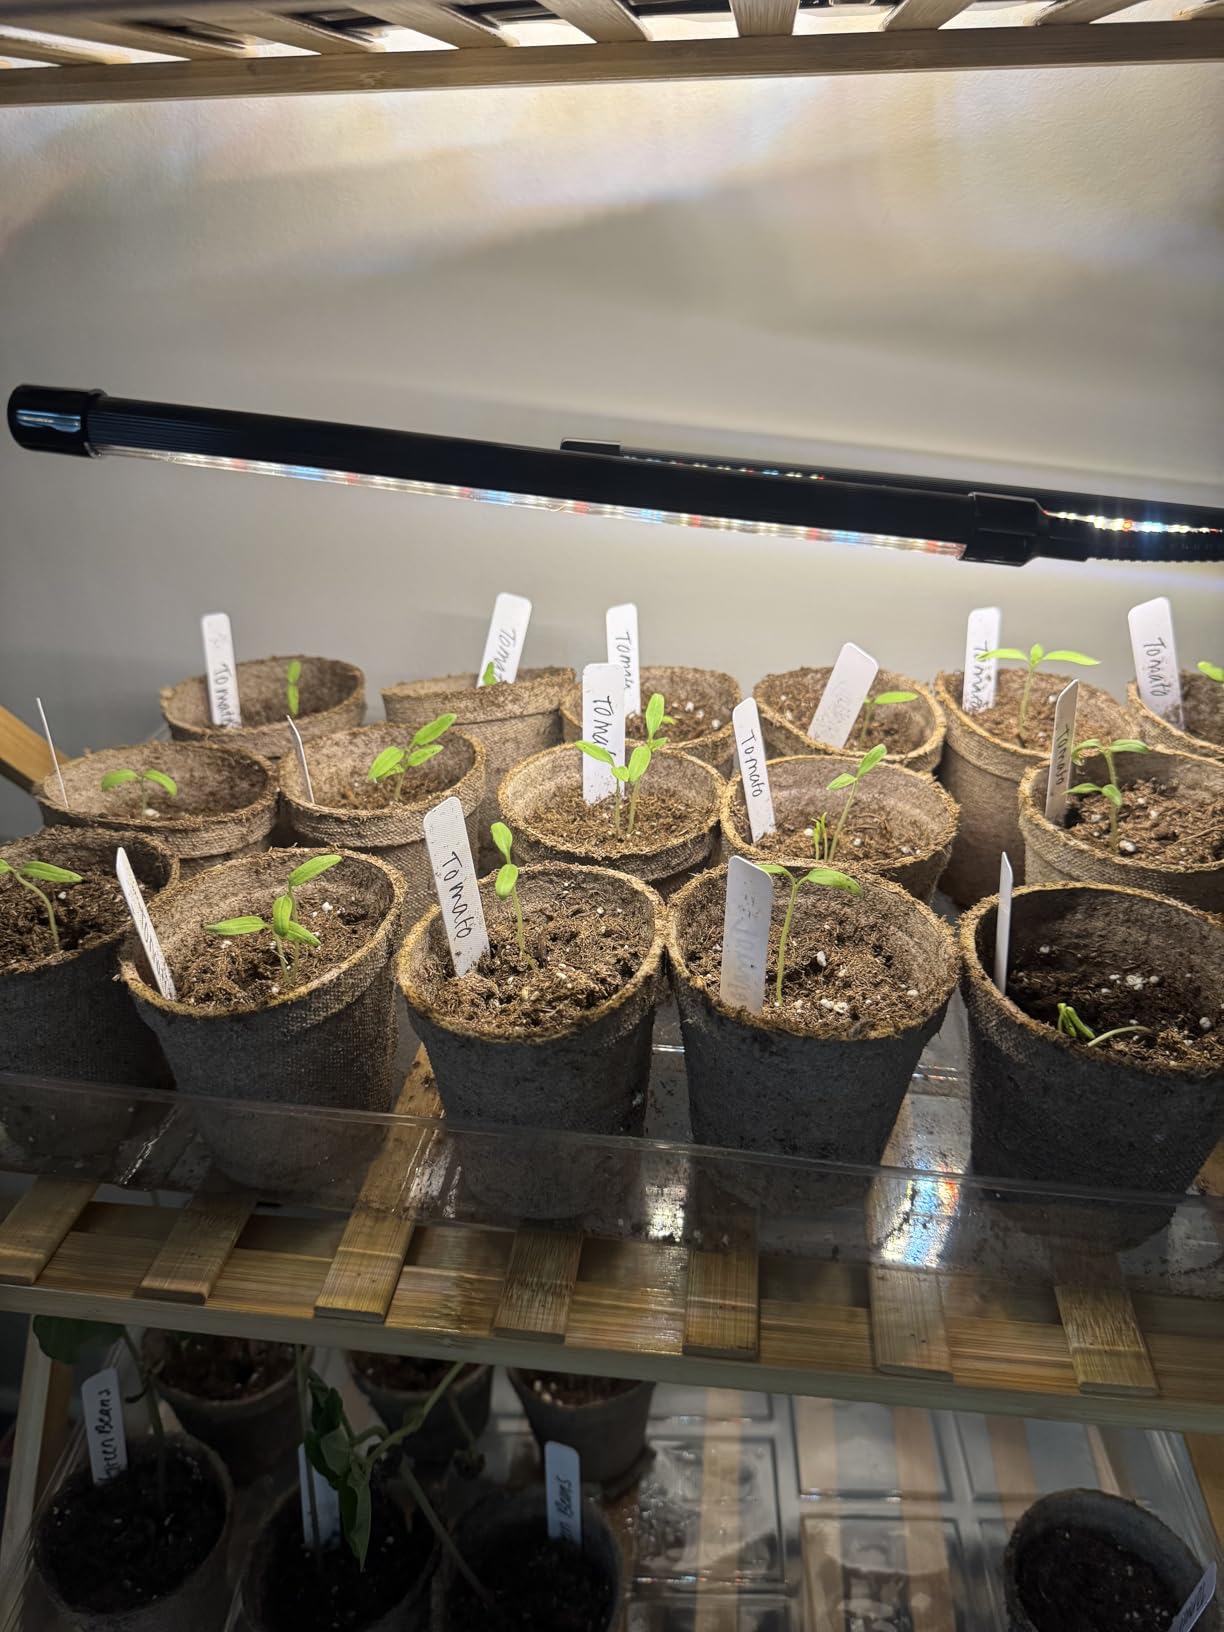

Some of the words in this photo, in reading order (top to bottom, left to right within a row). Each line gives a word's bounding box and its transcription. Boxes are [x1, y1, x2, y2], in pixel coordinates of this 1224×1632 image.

[1143, 636, 1171, 697] Tomato
[741, 729, 765, 798] Tomato
[442, 851, 475, 939] Tomato
[95, 1388, 113, 1434] Beans
